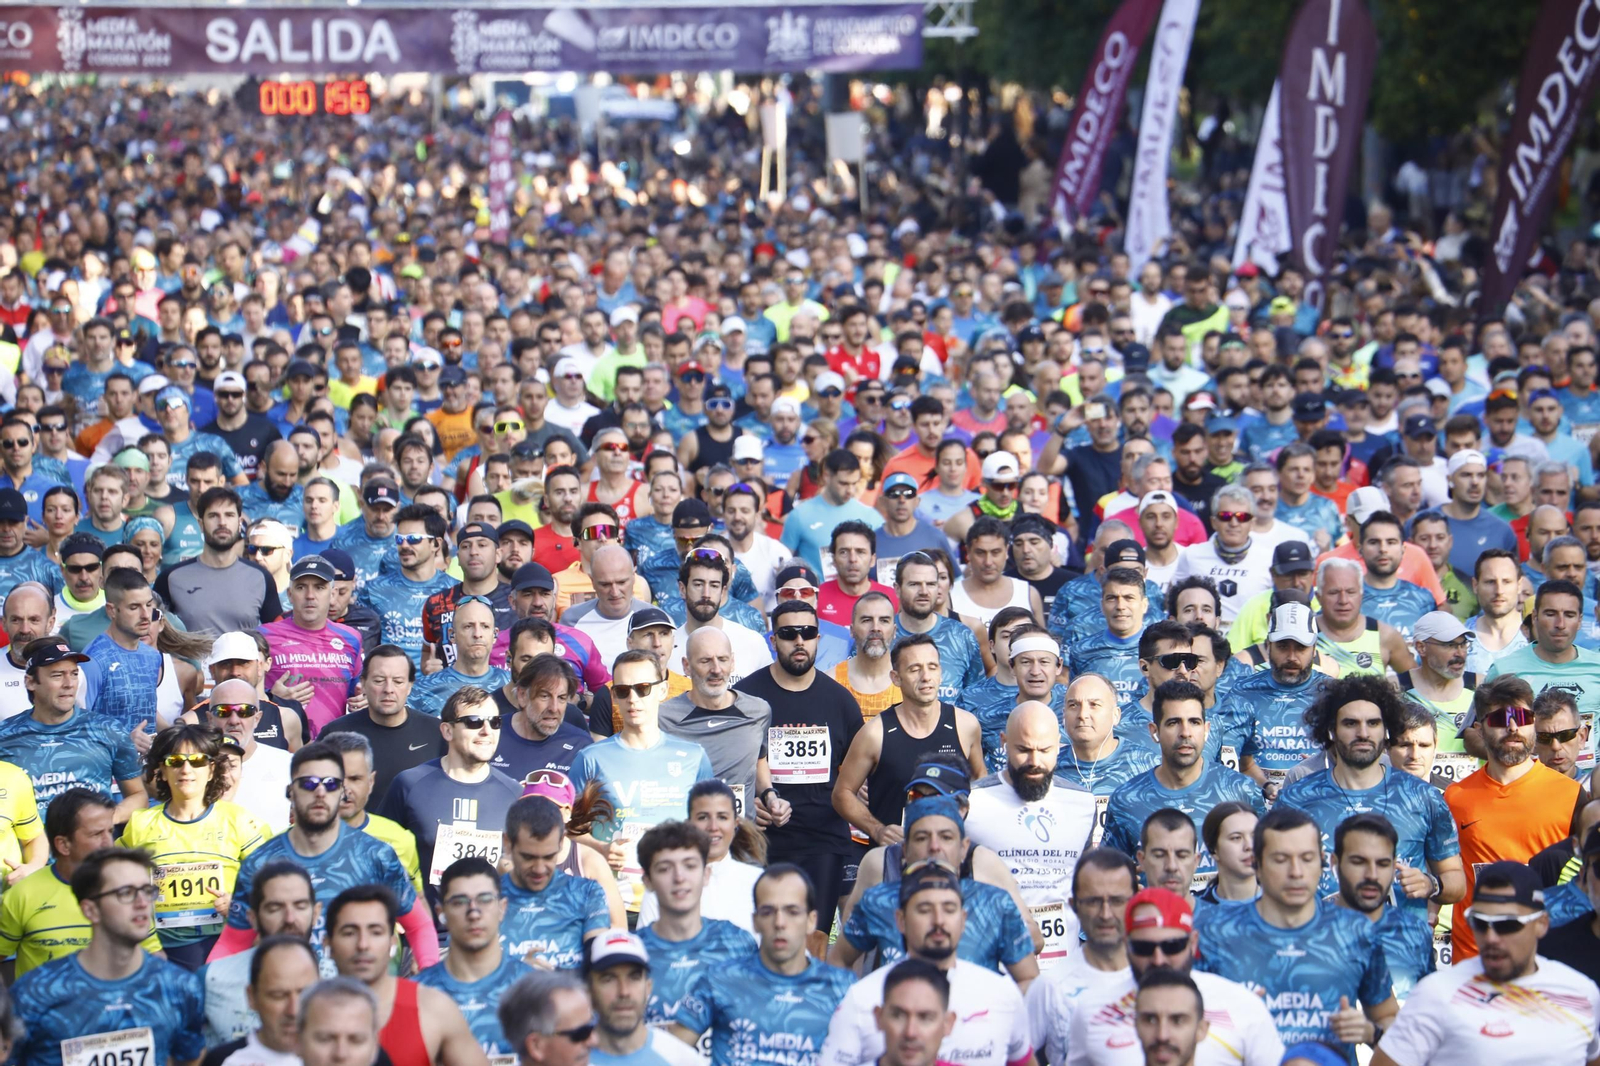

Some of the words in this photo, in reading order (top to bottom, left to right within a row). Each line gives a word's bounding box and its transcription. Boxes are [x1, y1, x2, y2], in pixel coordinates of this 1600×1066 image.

[86, 18, 138, 34] MEDIA
[87, 29, 171, 51] MARATÓN
[205, 17, 400, 63] SALIDA
[629, 22, 740, 50] IMDECO
[1508, 0, 1600, 201] IMDEC
[1059, 30, 1128, 195] IMDECO
[1210, 565, 1248, 577] ÉLITE
[275, 654, 286, 665] III
[289, 653, 316, 664] MEDIA
[1112, 680, 1139, 692] EDIA
[770, 730, 783, 740] 38
[1262, 726, 1307, 738] MEDIA
[784, 740, 827, 757] 3851
[1265, 752, 1302, 761] CORDOB
[32, 772, 77, 787] MEDIA
[612, 780, 639, 807] V
[452, 842, 499, 864] 3845
[998, 848, 1039, 857] CLÍNICA
[1042, 849, 1062, 857] DEL
[1064, 850, 1078, 858] PIE
[167, 865, 187, 873] MEDIA
[1020, 867, 1034, 875] 722
[168, 876, 219, 898] 1910
[1034, 903, 1063, 914] MARATÓN
[1041, 917, 1065, 938] 56
[509, 939, 560, 955] MEDIA
[1265, 992, 1324, 1010] MEDIA
[758, 1033, 814, 1052] MEDIA
[87, 1047, 151, 1066] 4057
